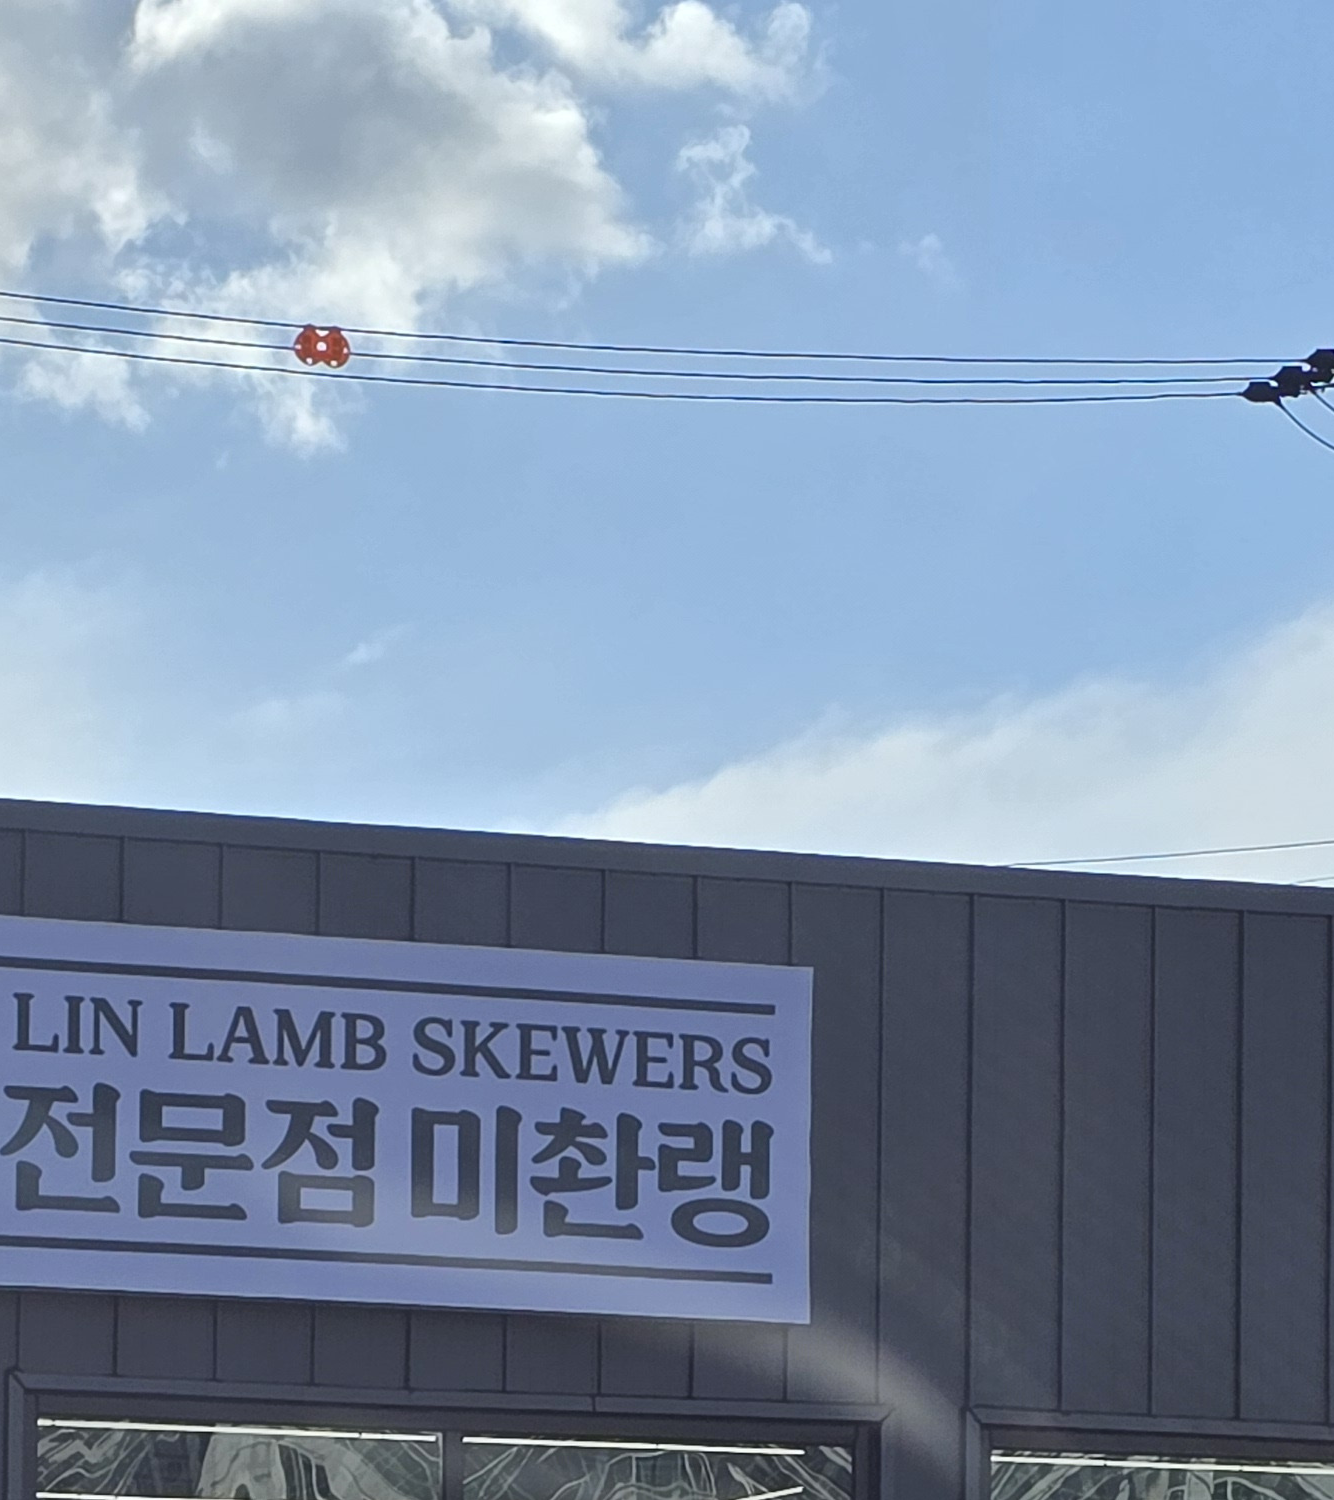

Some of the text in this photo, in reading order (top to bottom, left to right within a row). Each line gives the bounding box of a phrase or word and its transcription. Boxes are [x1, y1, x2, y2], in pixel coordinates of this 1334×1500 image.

[12, 991, 143, 1056] LIN
[167, 1000, 386, 1073] LAMB
[411, 1016, 774, 1096] SKEWERS
[0, 1082, 378, 1228] 전문점
[409, 1105, 774, 1249] 미촨랭
